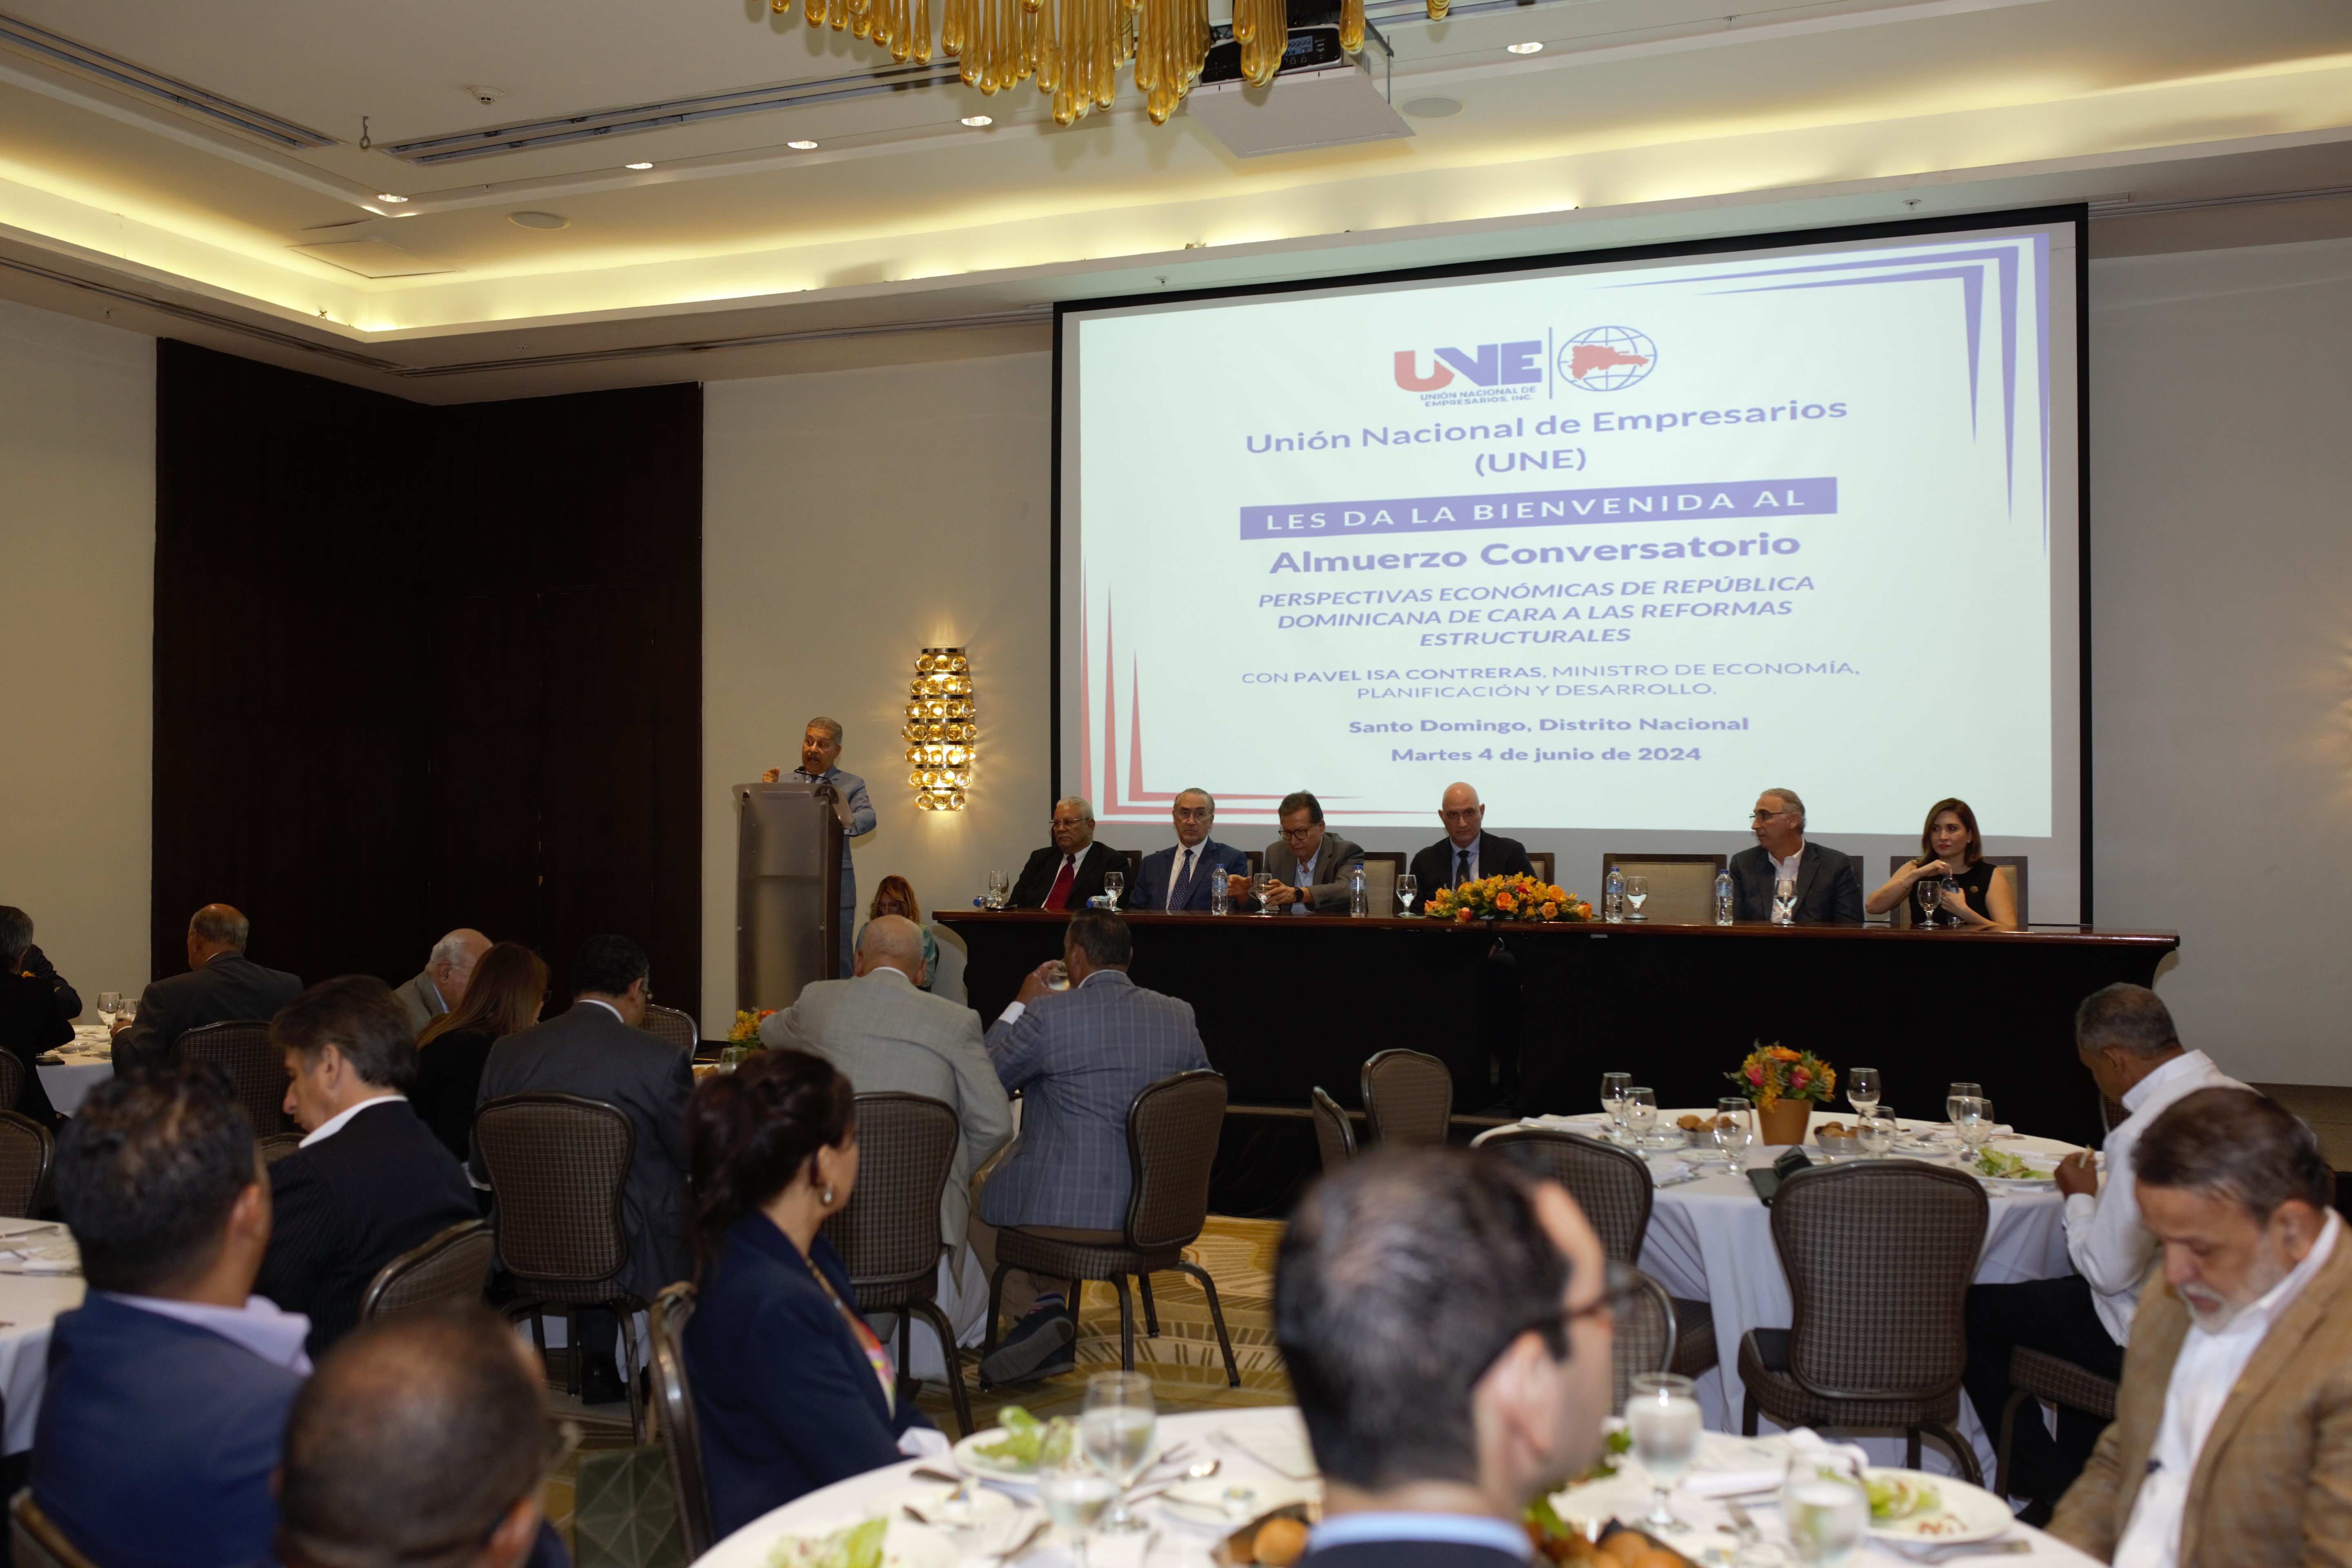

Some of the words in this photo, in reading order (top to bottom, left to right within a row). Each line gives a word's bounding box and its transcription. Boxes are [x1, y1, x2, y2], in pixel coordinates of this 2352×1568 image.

[1394, 340, 1542, 392] UNE
[1420, 391, 1457, 401] UNIÓN
[1460, 388, 1518, 398] NACIONAL
[1247, 431, 1350, 454] Unión
[1363, 417, 1523, 447] Nacional
[1535, 415, 1581, 436] de
[1593, 400, 1847, 432] Empresarios
[1475, 448, 1586, 477] (UNE)
[1267, 513, 1325, 530] LES
[1345, 510, 1394, 526] DA
[1412, 507, 1455, 523] LA
[1473, 493, 1735, 520] BIENVENIDA
[1753, 490, 1804, 507] AL
[1269, 551, 1468, 574] Almuerzo
[1480, 532, 1801, 566] Conversatorio
[1259, 588, 1433, 608] PERSPECTIVAS
[1439, 582, 1615, 601] ECONÓMICAS
[1620, 581, 1657, 595] DE
[1663, 576, 1815, 594] REPÚBLICA
[1278, 610, 1441, 629] DOMINICANA
[1448, 609, 1482, 624] DE
[1487, 607, 1557, 622] CARA
[1562, 606, 1581, 620] A
[1588, 605, 1635, 619] LAS
[1641, 601, 1793, 618] REFORMAS
[1420, 628, 1631, 646] ESTRUCTURALES
[1242, 673, 1288, 684] CON
[1294, 670, 1362, 683] PAVEL
[1367, 670, 1400, 680] ISA
[1405, 667, 1546, 680] CONTRERAS,
[1553, 665, 1668, 677] MINISTRO
[1675, 664, 1705, 675] DE
[1713, 660, 1860, 675] ECONOMÍA,
[1358, 684, 1529, 699] PLANIFICACIÓN
[1536, 686, 1550, 696] Y
[1556, 683, 1716, 696] DESARROLLO.
[1349, 721, 1414, 733] Santo
[1420, 719, 1532, 734] Domingo,
[1539, 718, 1631, 731] Distrito
[1639, 717, 1748, 731] Nacional
[1392, 748, 1472, 762] Martes
[1478, 748, 1493, 761] 4
[1499, 748, 1529, 761] de
[1533, 747, 1595, 763] junio
[1601, 747, 1631, 761] de
[1638, 747, 1702, 761] 2024
